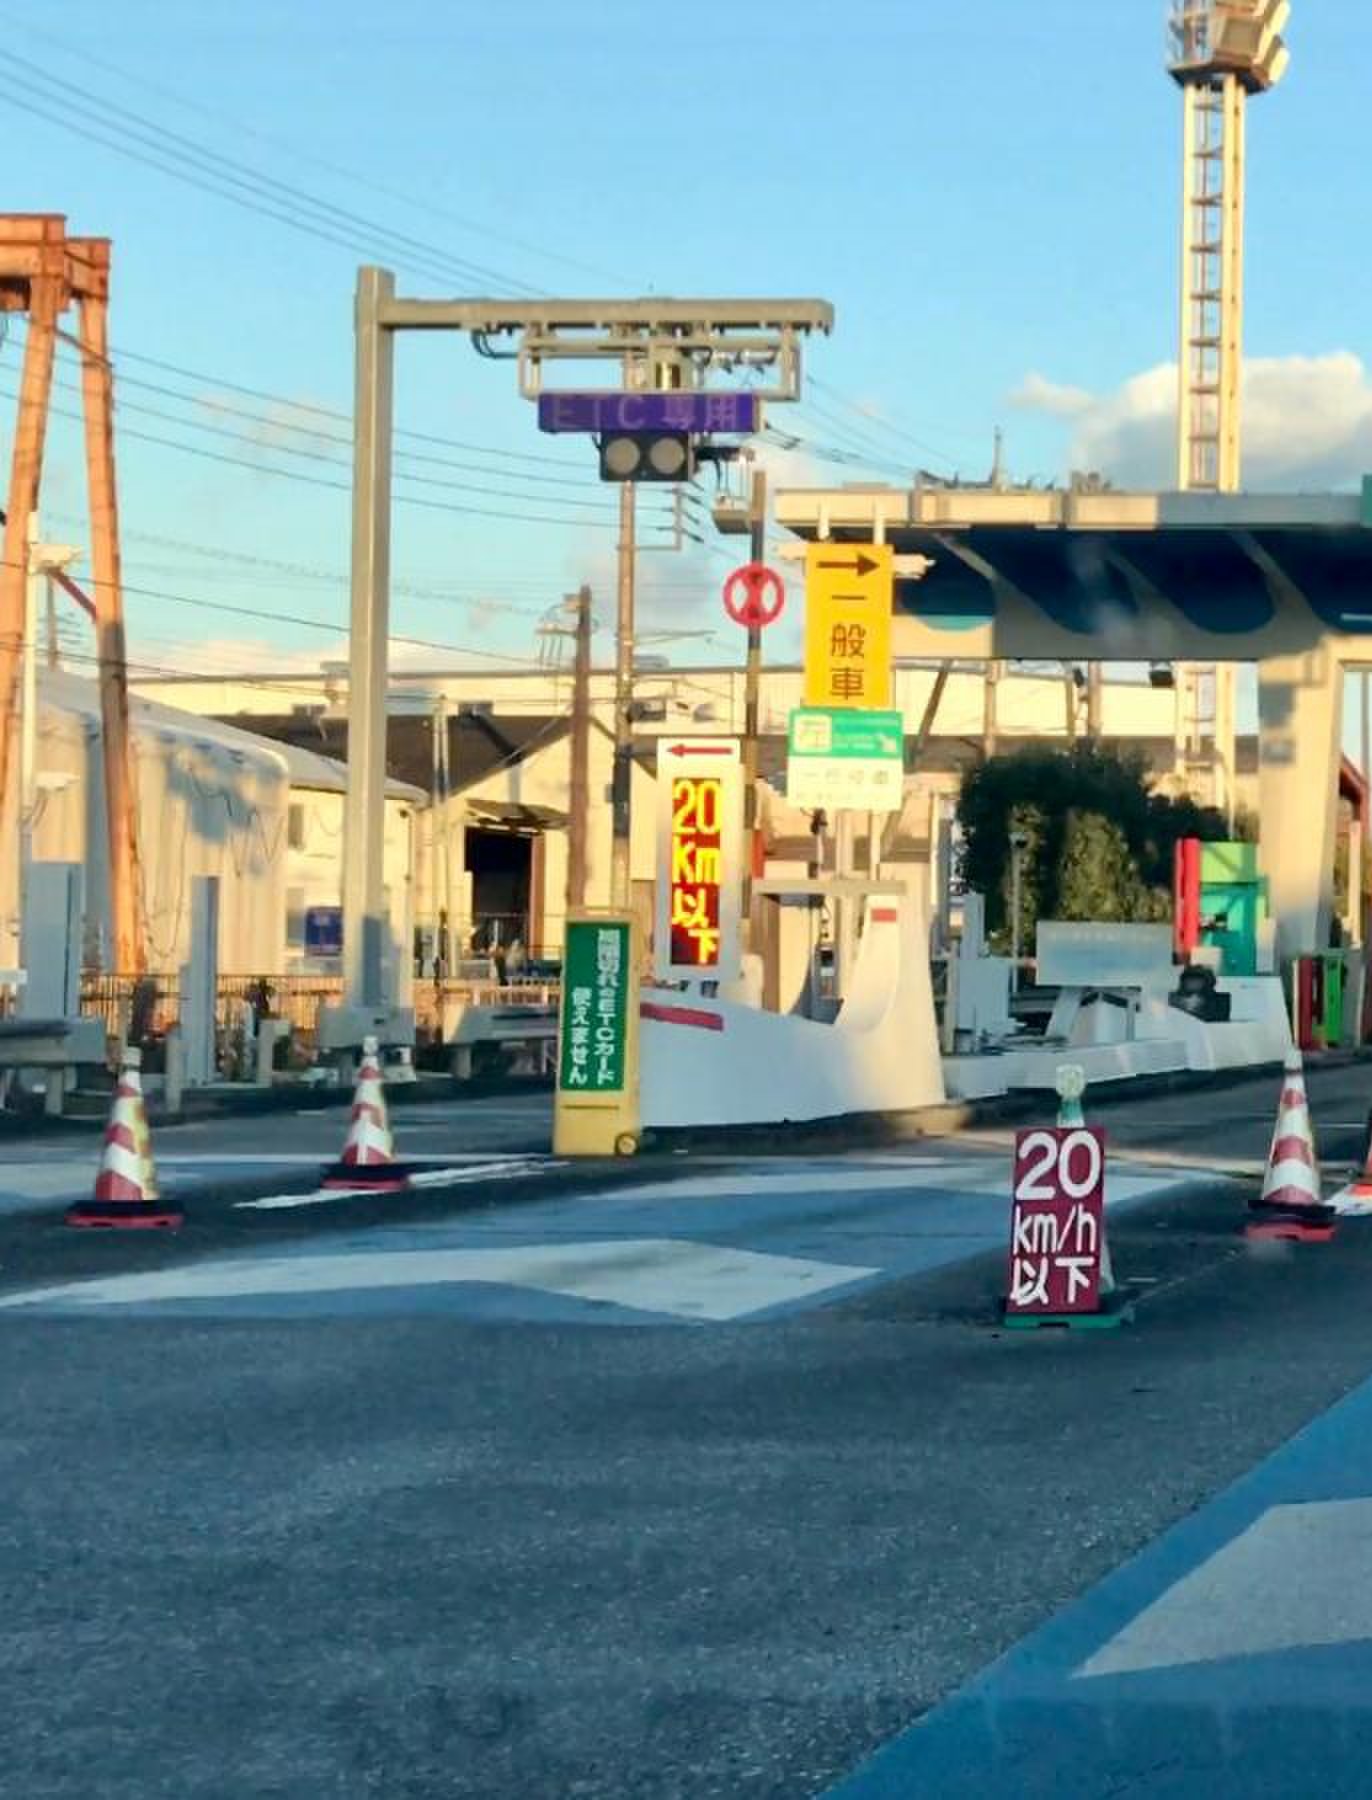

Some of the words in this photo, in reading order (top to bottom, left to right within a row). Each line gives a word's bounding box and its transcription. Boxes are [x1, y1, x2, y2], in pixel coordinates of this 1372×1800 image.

[829, 592, 867, 701] 一般車
[673, 779, 722, 835] 20
[1015, 1130, 1101, 1200] 20
[1012, 1203, 1097, 1255] km/h
[1010, 1256, 1096, 1306] 以下
